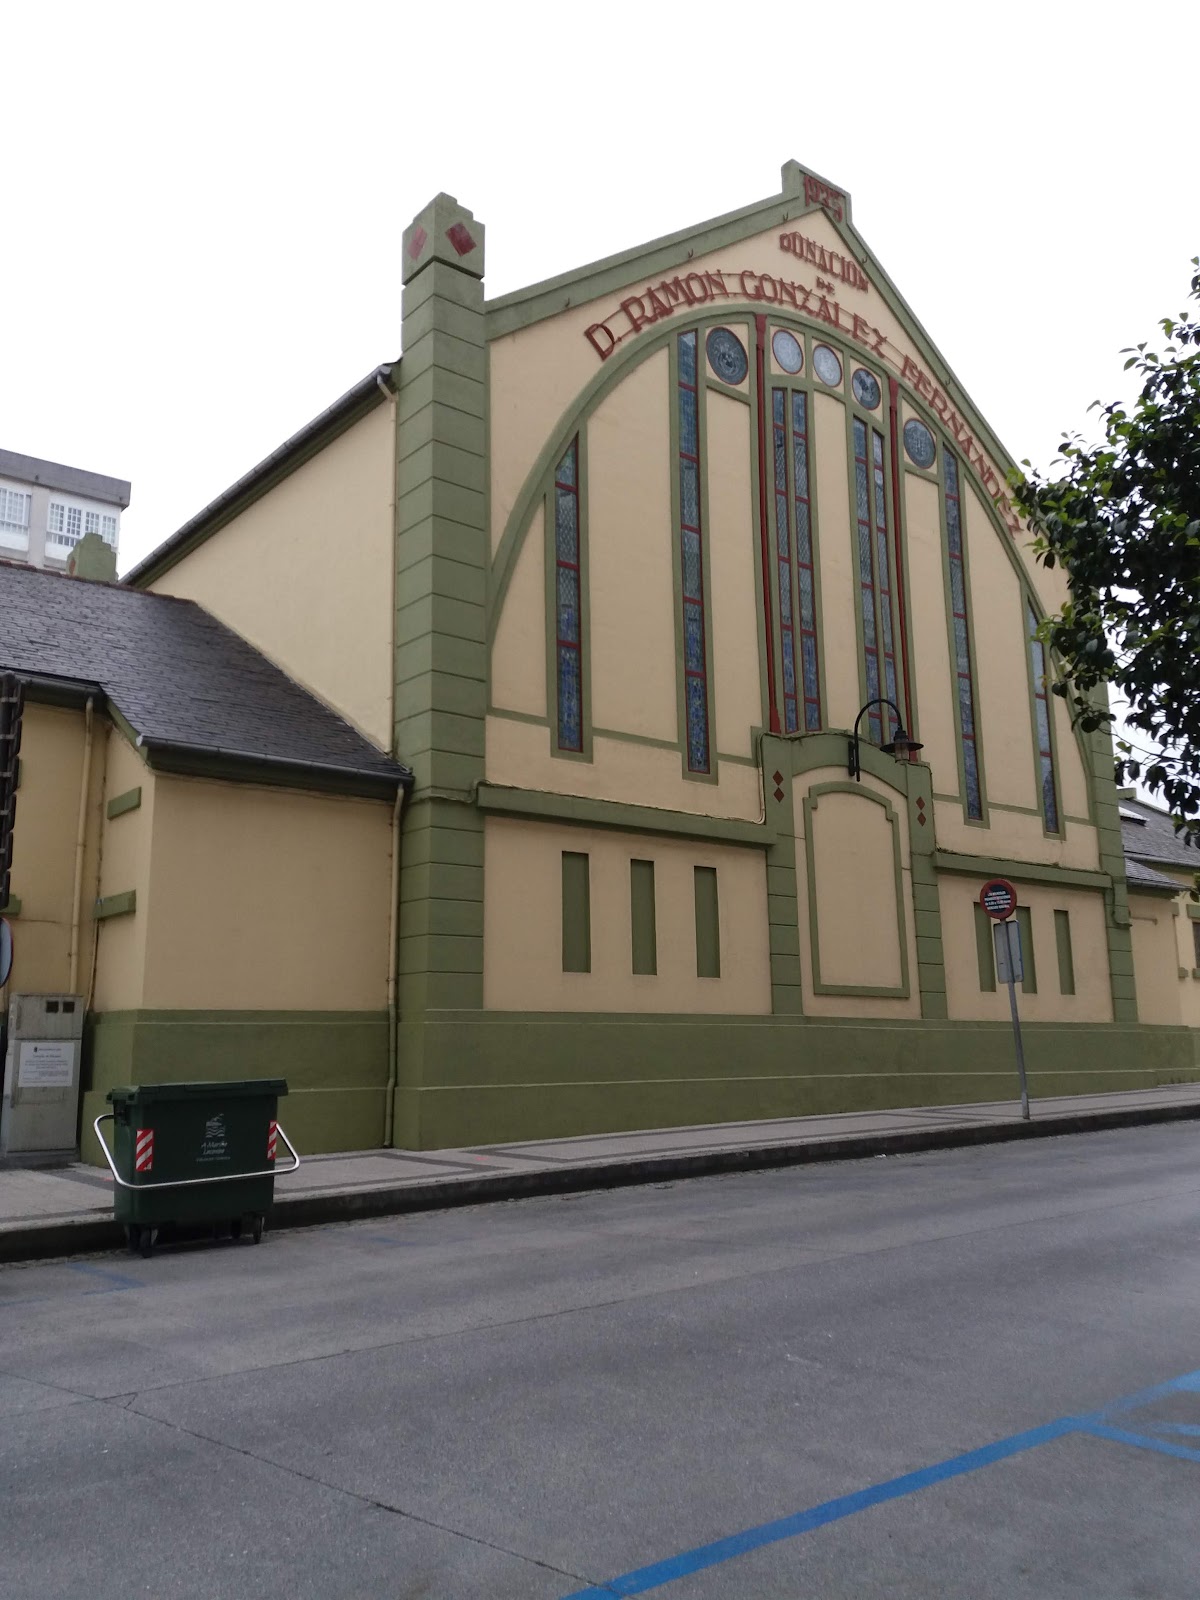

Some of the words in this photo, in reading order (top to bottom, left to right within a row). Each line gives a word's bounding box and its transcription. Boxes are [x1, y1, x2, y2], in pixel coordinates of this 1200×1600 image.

[804, 175, 843, 223] 1935
[815, 275, 835, 296] DE
[584, 323, 622, 362] D.
[620, 269, 730, 333] RAMON
[740, 270, 888, 360] GONZALEZ
